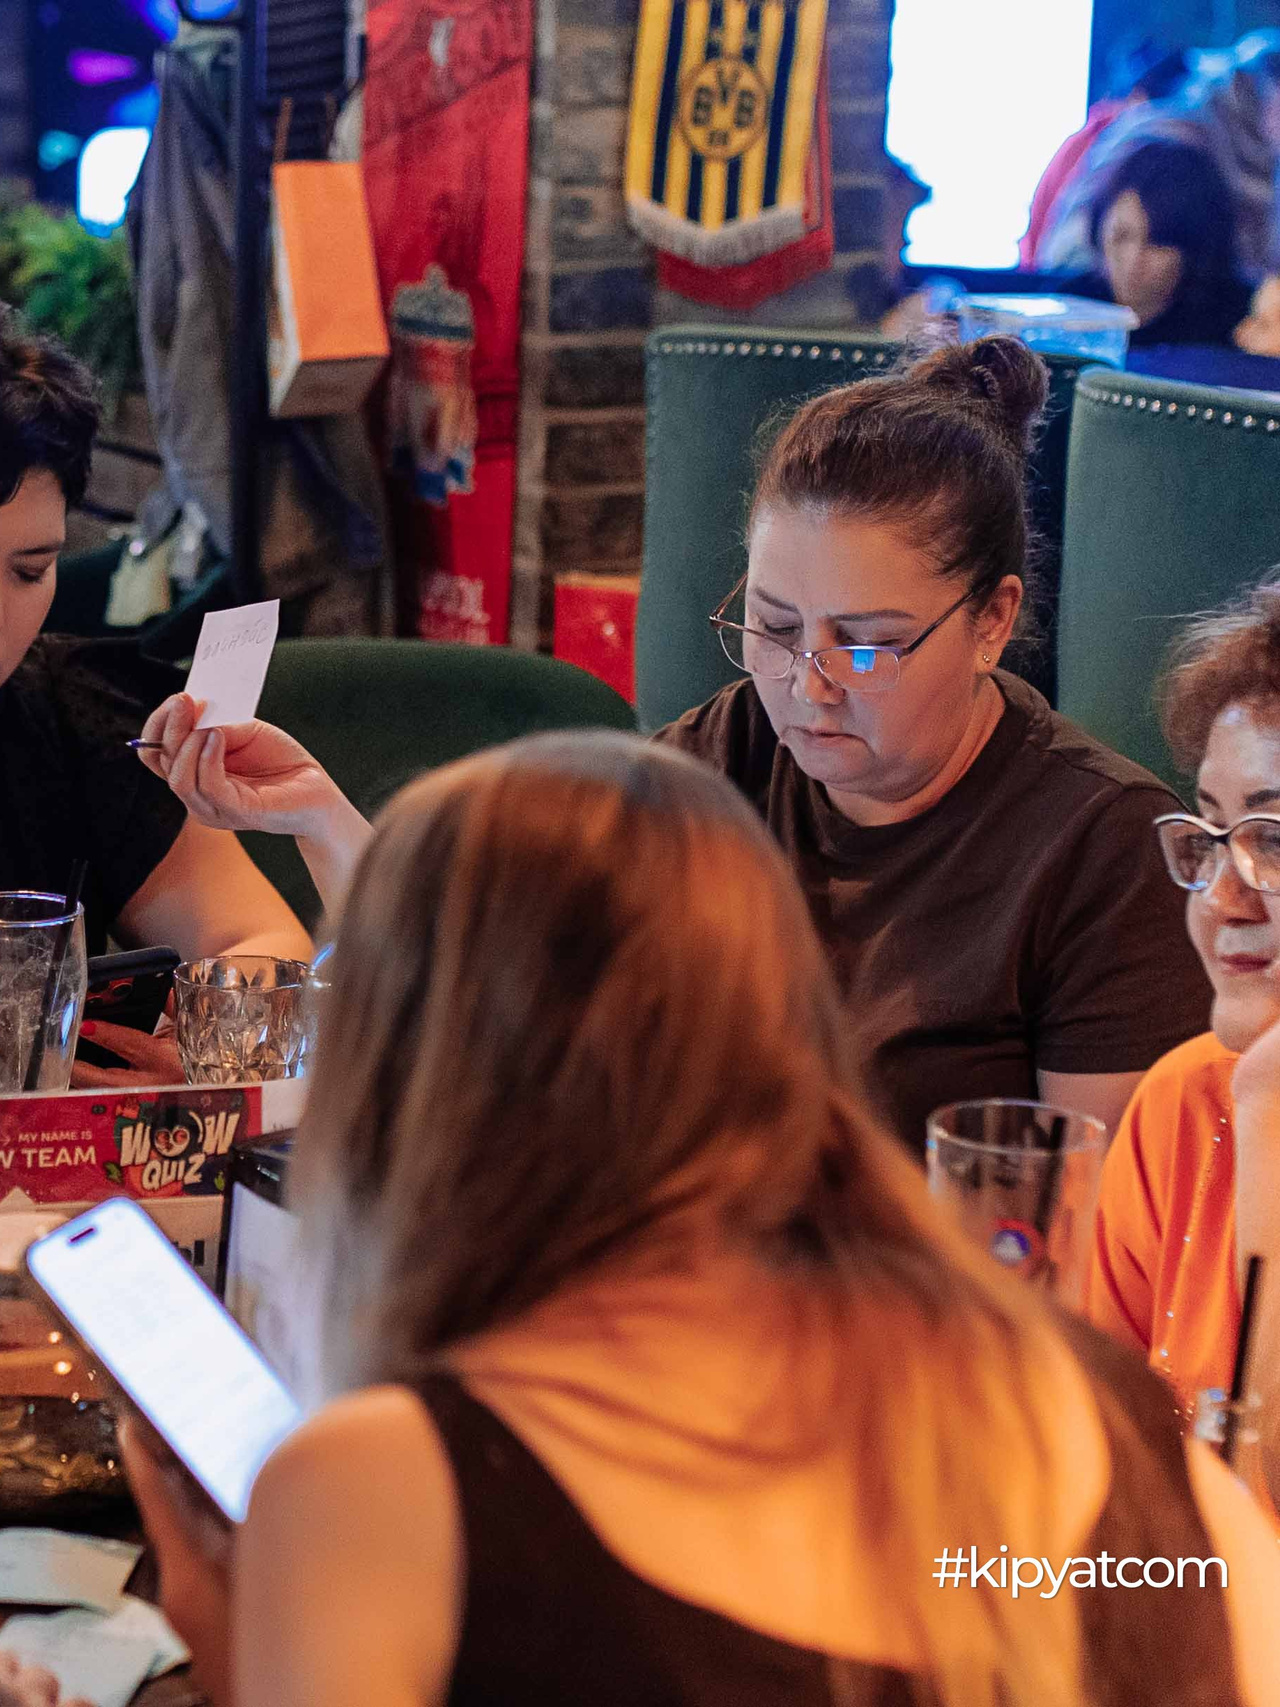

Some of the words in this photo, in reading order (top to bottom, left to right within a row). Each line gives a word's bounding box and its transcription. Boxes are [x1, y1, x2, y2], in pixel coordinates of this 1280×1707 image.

[689, 63, 758, 129] BVB
[18, 1133, 37, 1143] MY
[40, 1131, 79, 1142] NAME
[81, 1130, 93, 1141] IS
[22, 1145, 97, 1169] TEAM
[142, 1153, 206, 1191] QUIZ
